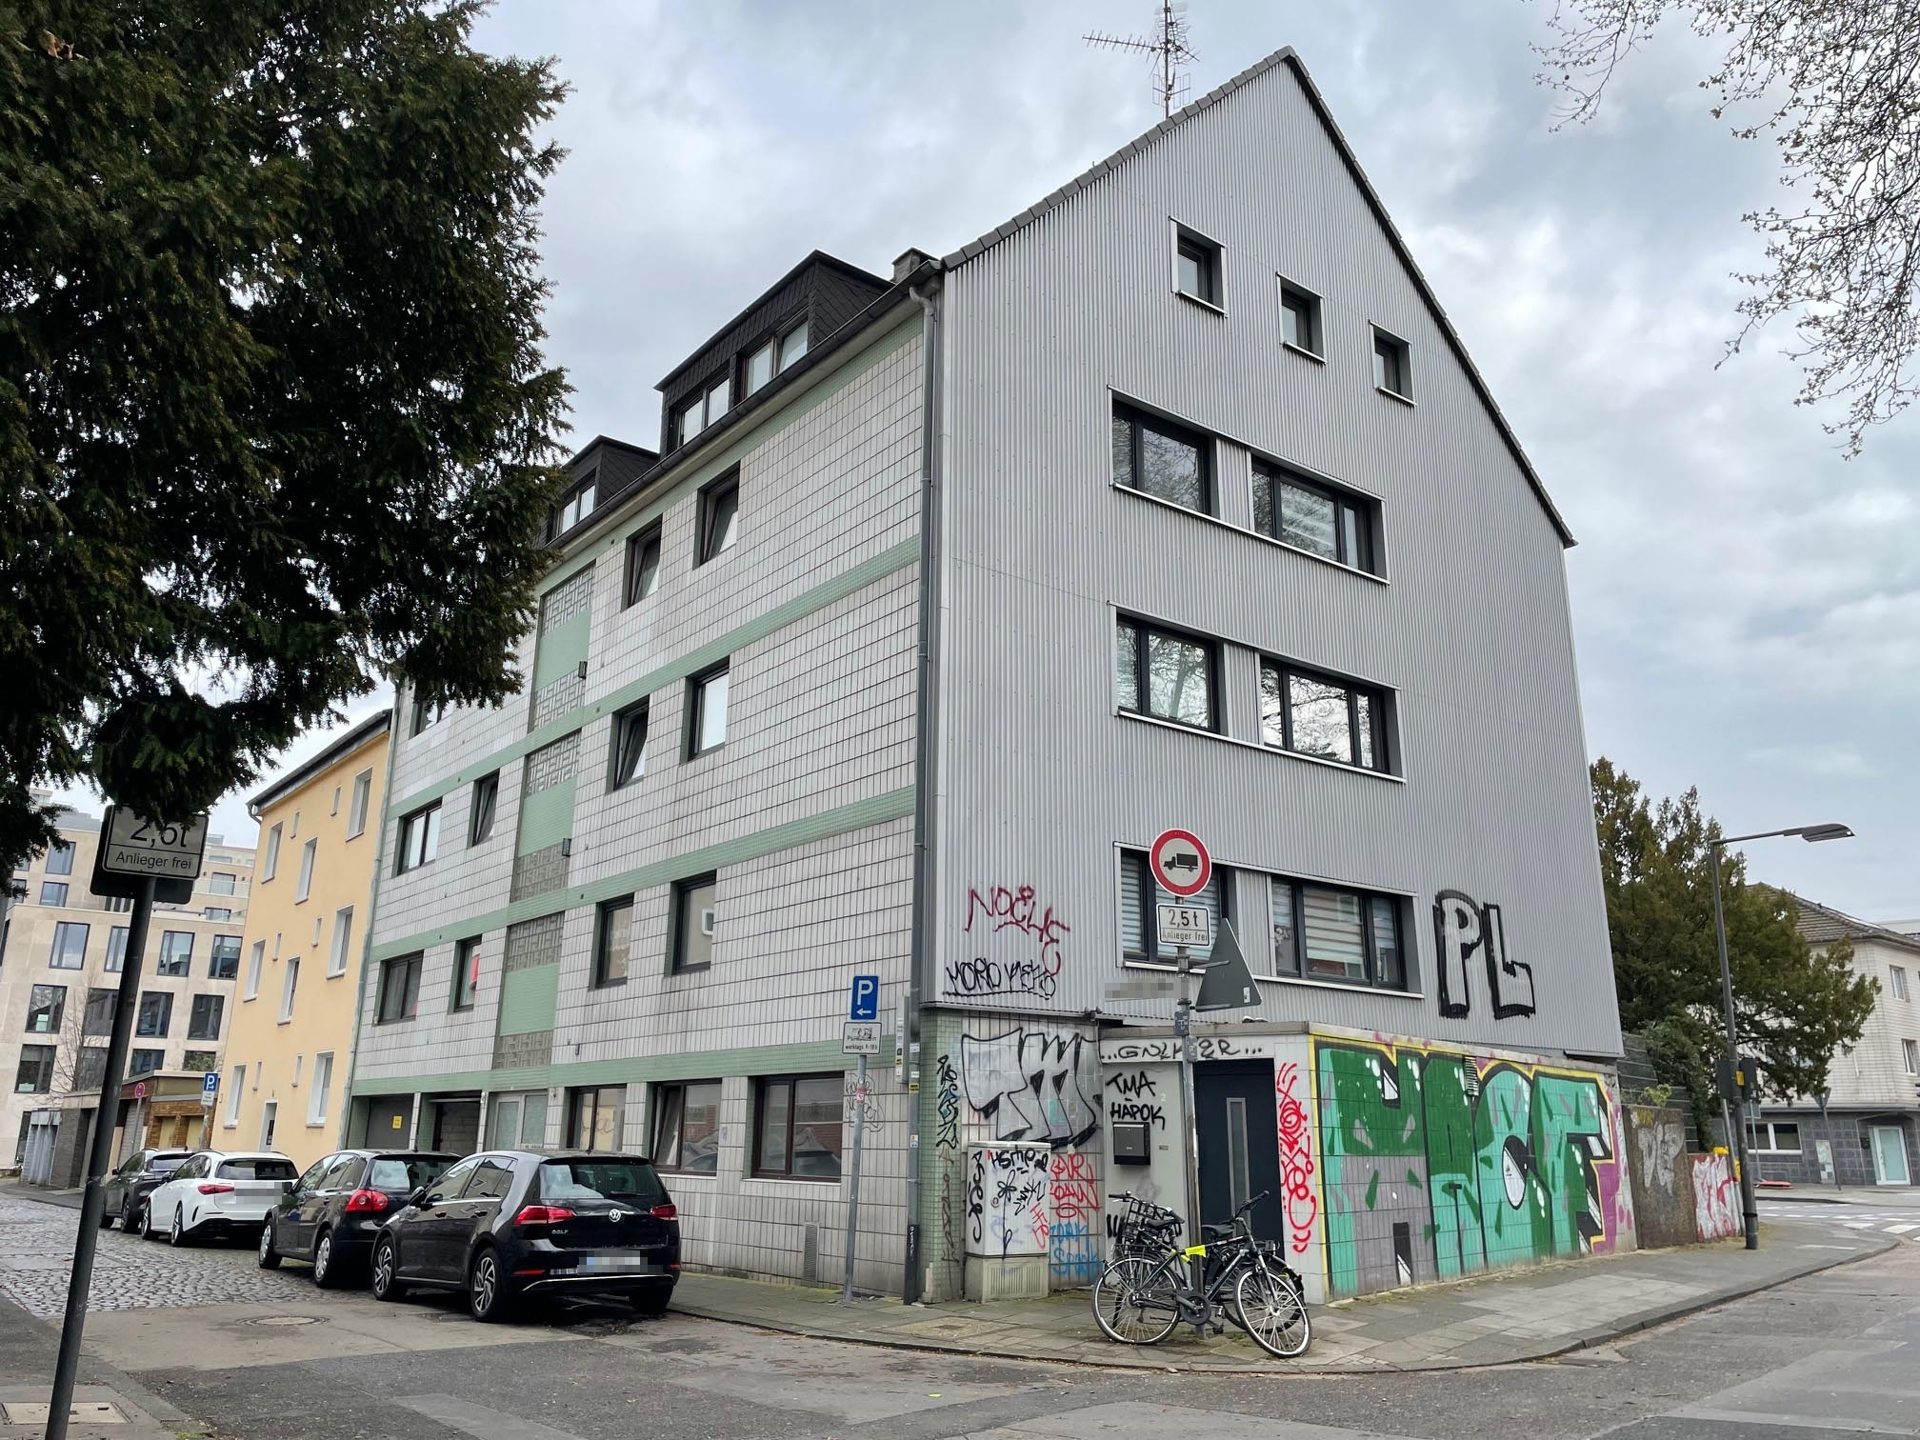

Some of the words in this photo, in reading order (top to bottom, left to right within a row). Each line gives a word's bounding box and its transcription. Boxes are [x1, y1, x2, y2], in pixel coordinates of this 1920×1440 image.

[115, 851, 168, 869] Anlieger
[171, 856, 192, 870] frei
[1168, 908, 1190, 928] 2,5
[1193, 911, 1199, 928] t
[856, 980, 874, 1006] P
[1106, 1071, 1156, 1098] TMA
